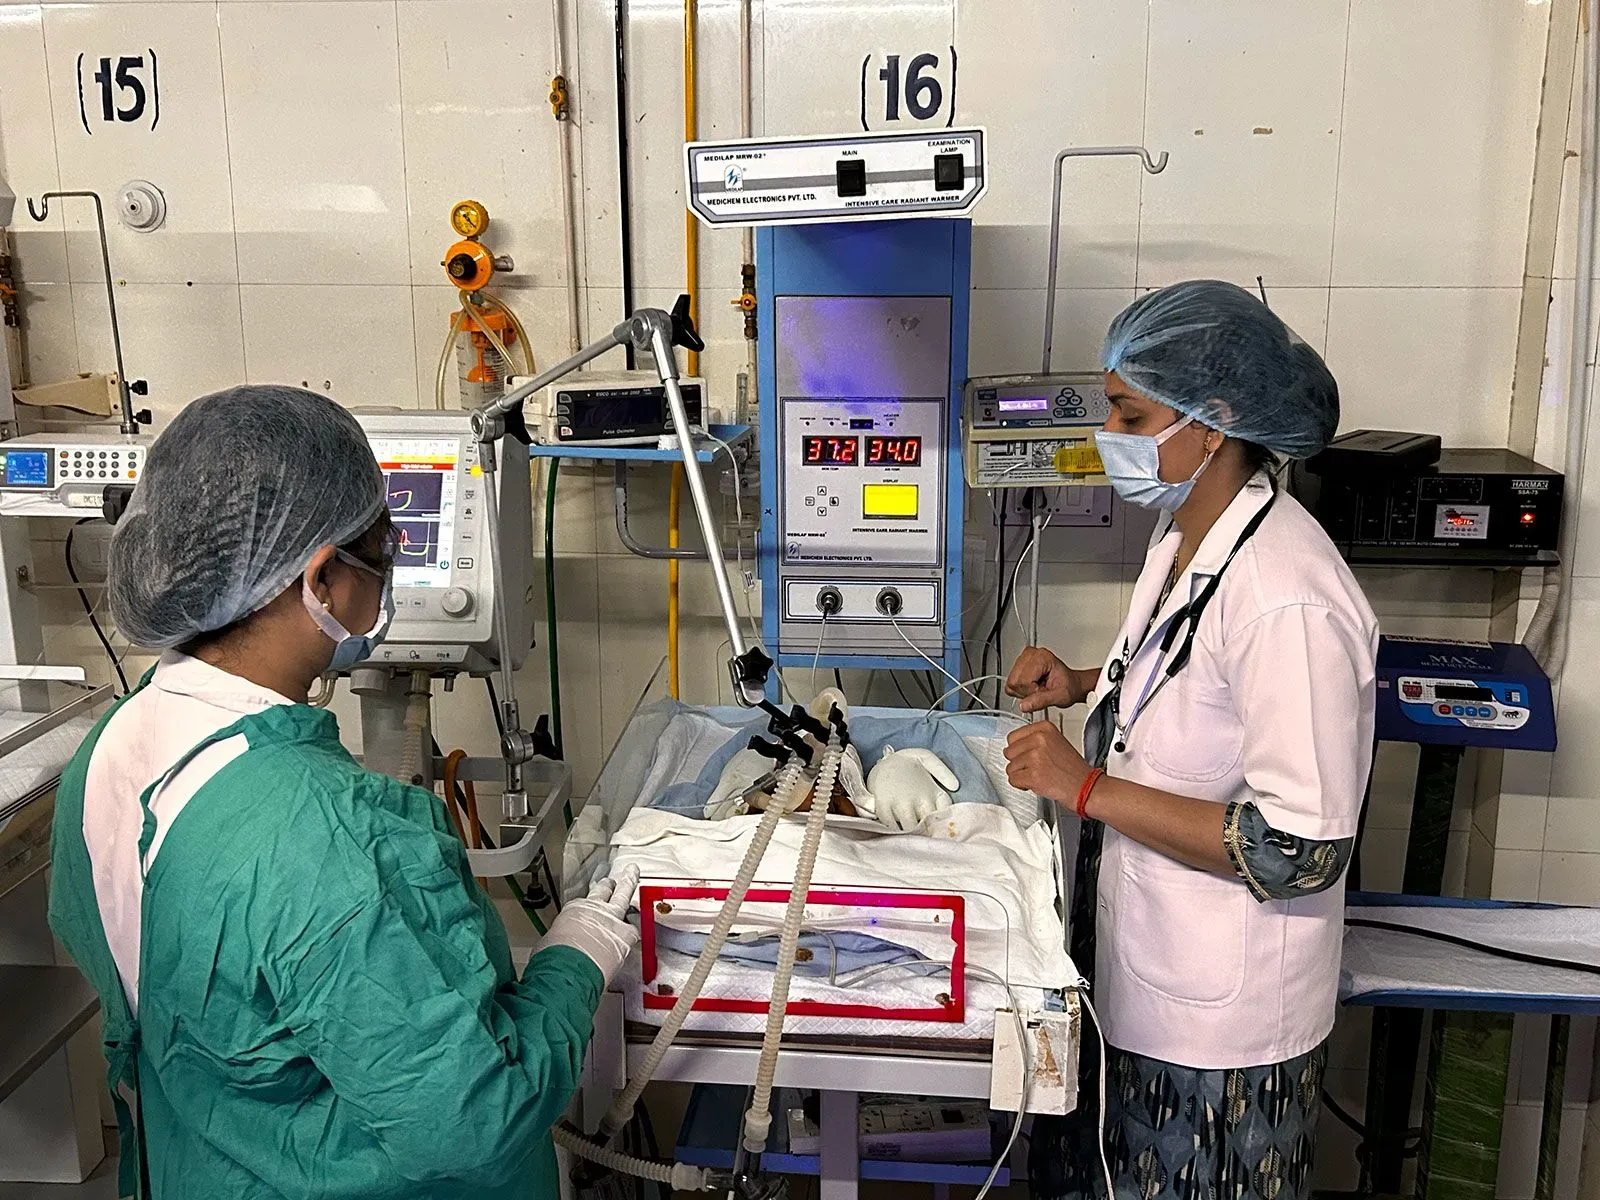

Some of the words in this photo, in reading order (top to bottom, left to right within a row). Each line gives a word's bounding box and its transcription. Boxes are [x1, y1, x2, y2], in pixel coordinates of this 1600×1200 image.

[928, 139, 971, 147] EXAMINATION
[707, 197, 741, 205] MEDICHEM
[742, 195, 787, 204] ELECTRONICS
[803, 193, 817, 201] LTD.
[808, 439, 857, 461] 37.2
[870, 440, 918, 461] 34.0
